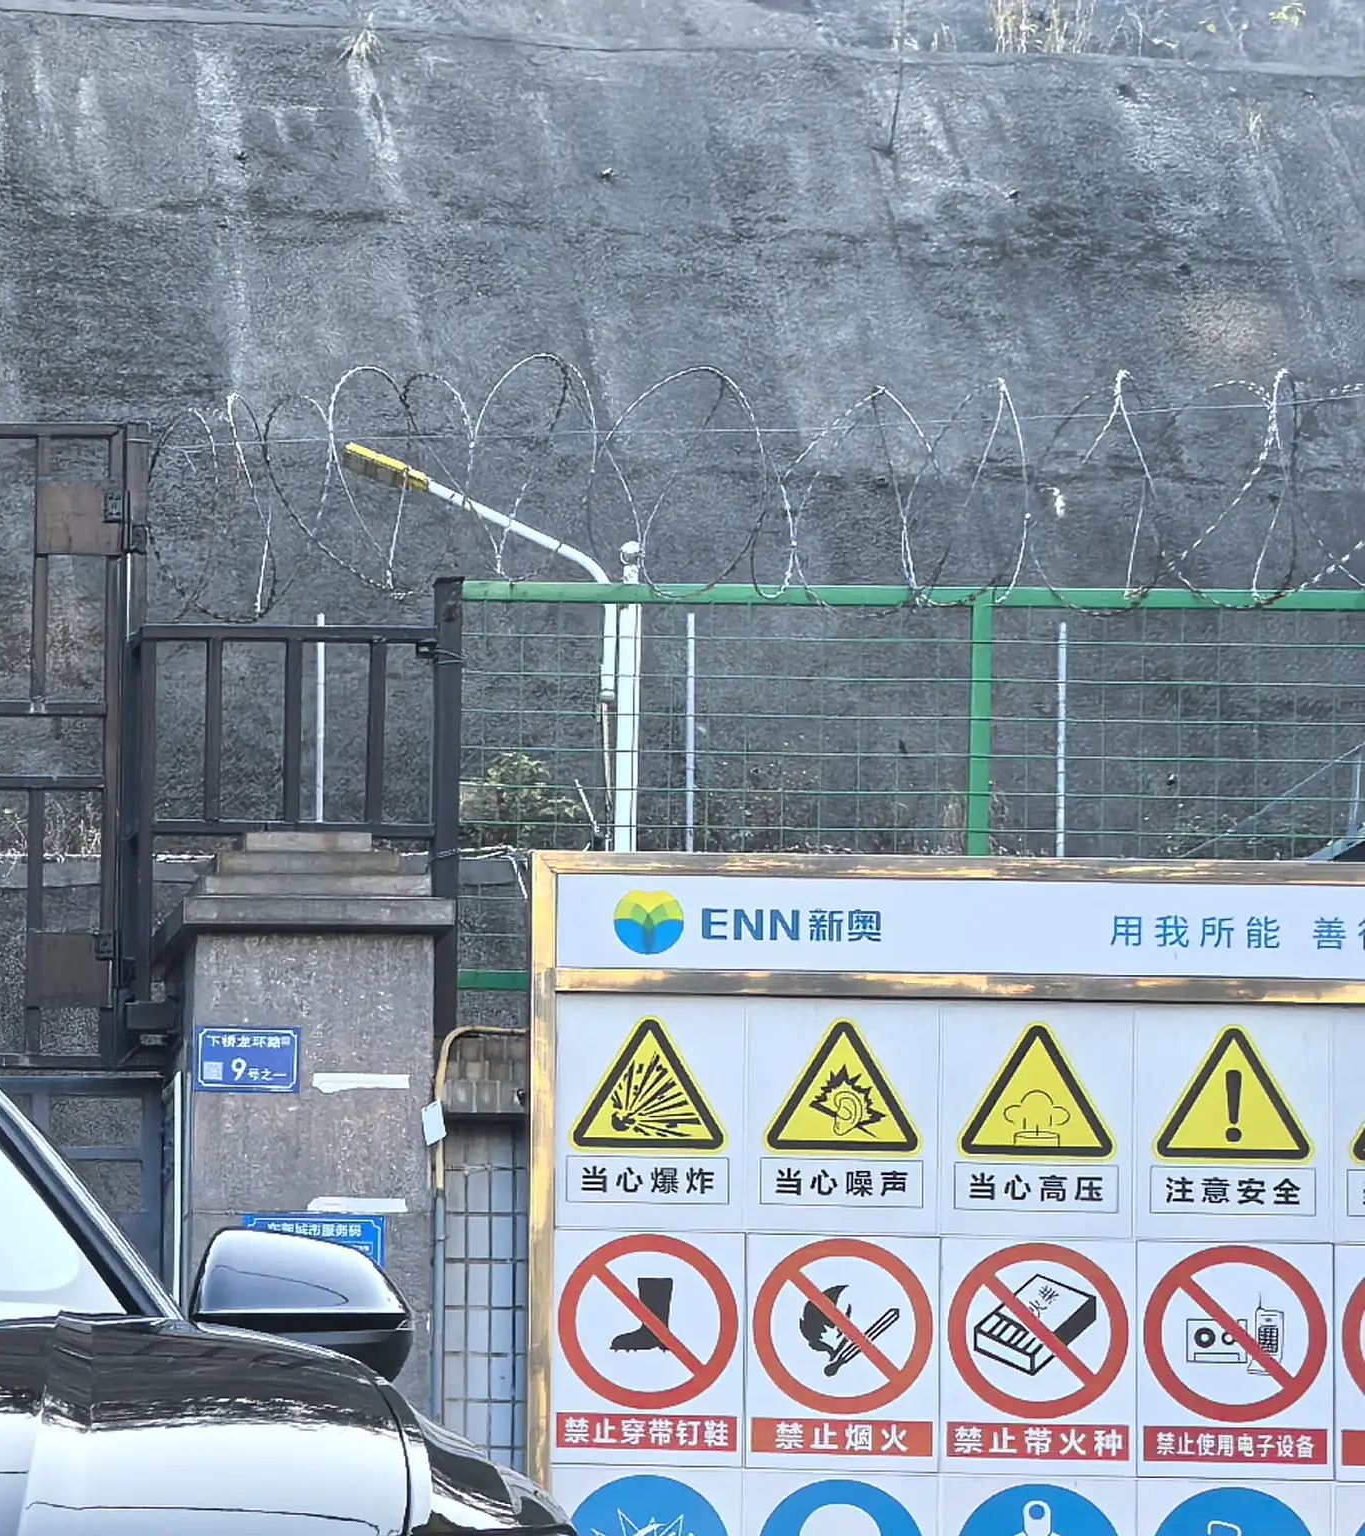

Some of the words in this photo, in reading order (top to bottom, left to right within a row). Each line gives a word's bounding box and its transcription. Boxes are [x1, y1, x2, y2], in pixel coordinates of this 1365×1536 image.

[1109, 914, 1281, 949] 用我所能
[1312, 916, 1365, 950] 善
[580, 1165, 715, 1195] 当心爆炸
[775, 1168, 909, 1198] 当心噪声
[968, 1172, 1104, 1203] 当心高压
[1166, 1175, 1301, 1205] 注意安全
[563, 1417, 730, 1448] 禁止穿带钉鞋
[774, 1421, 910, 1452] 禁止烟火
[953, 1425, 1125, 1458] 禁止带火种
[1156, 1431, 1315, 1459] 禁止使用电子设备
